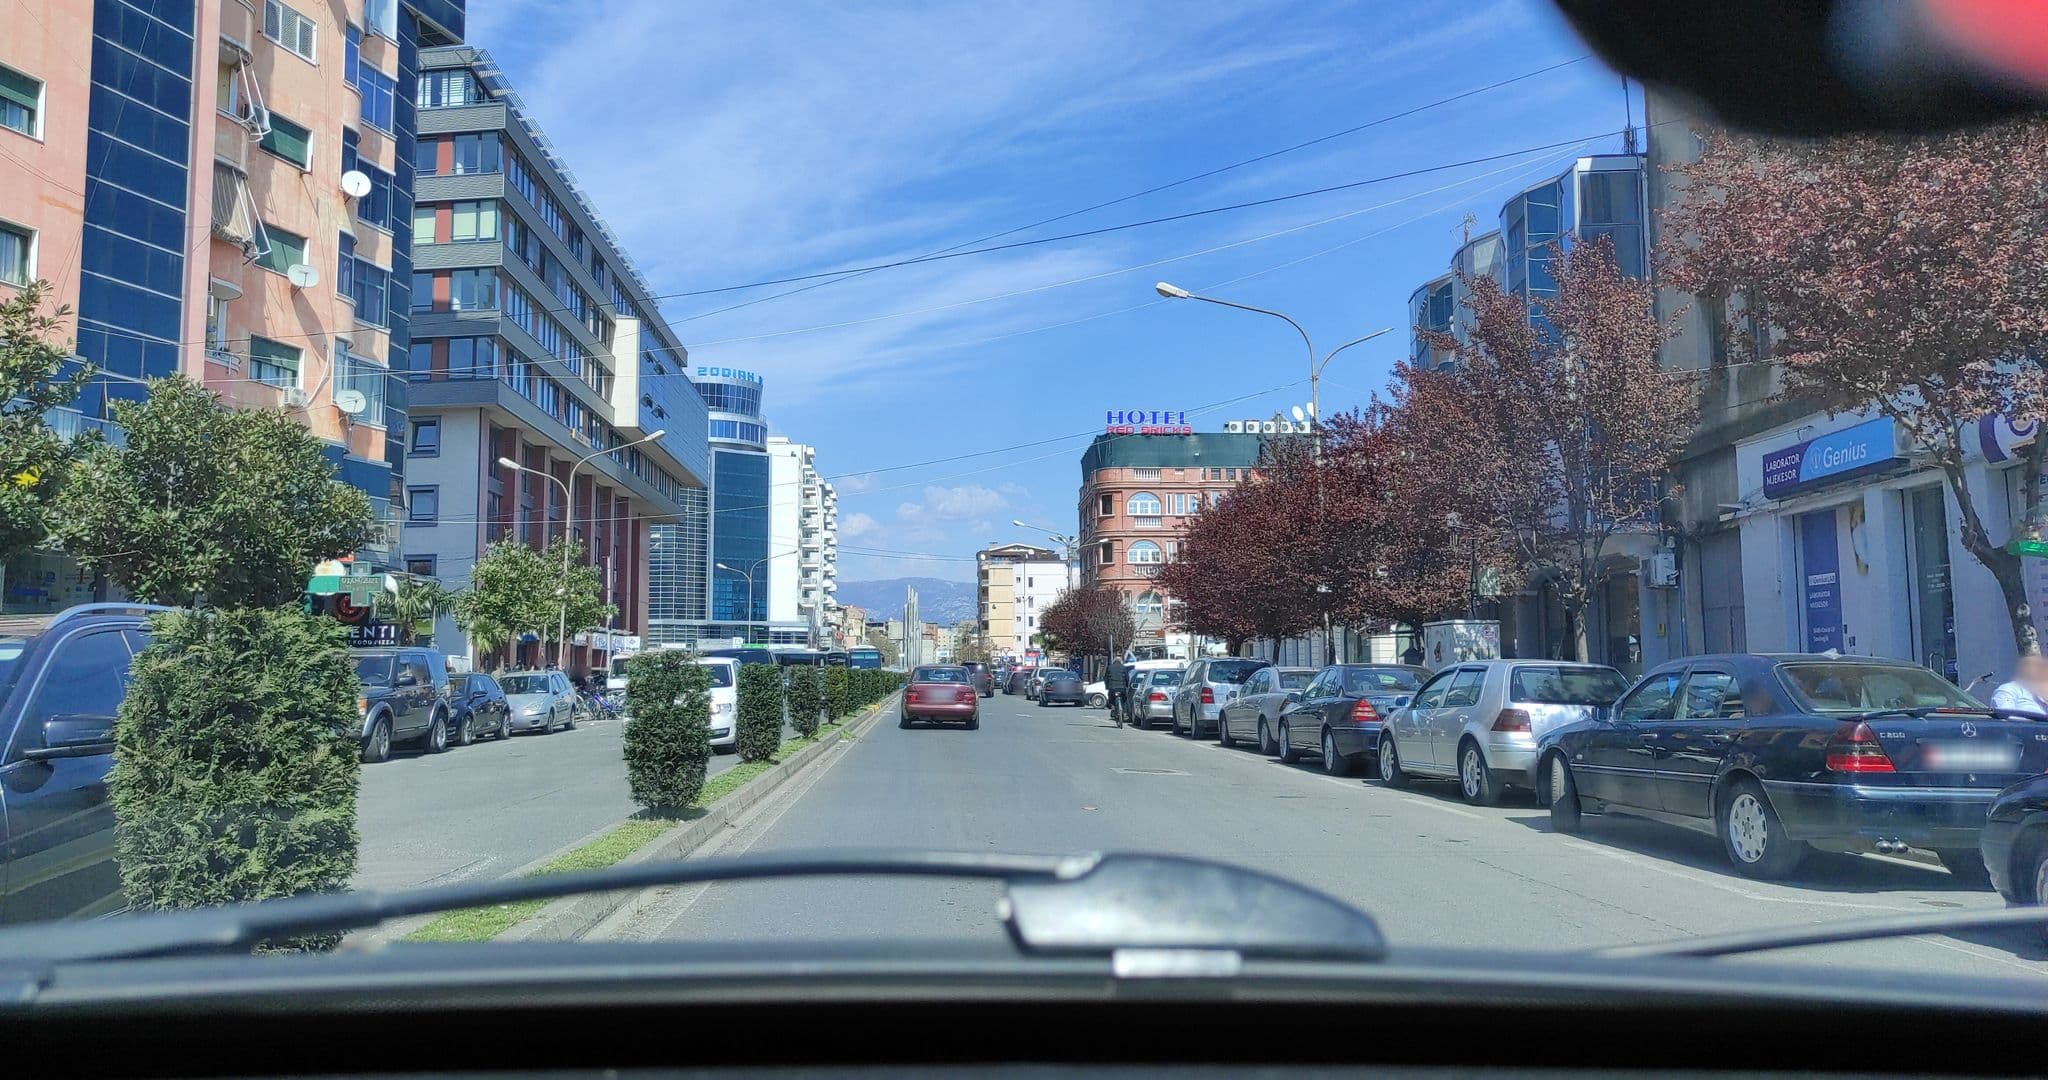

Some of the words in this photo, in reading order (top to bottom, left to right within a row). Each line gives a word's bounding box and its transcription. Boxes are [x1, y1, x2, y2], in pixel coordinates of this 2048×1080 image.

[1107, 411, 1190, 425] HOTEL
[1106, 426, 1135, 435] RED
[1141, 426, 1192, 435] BRICKS
[1765, 453, 1801, 472] LABORATOR
[1822, 441, 1867, 468] Genius
[1766, 469, 1798, 487] MJEKESOR
[350, 625, 396, 639] ENTI
